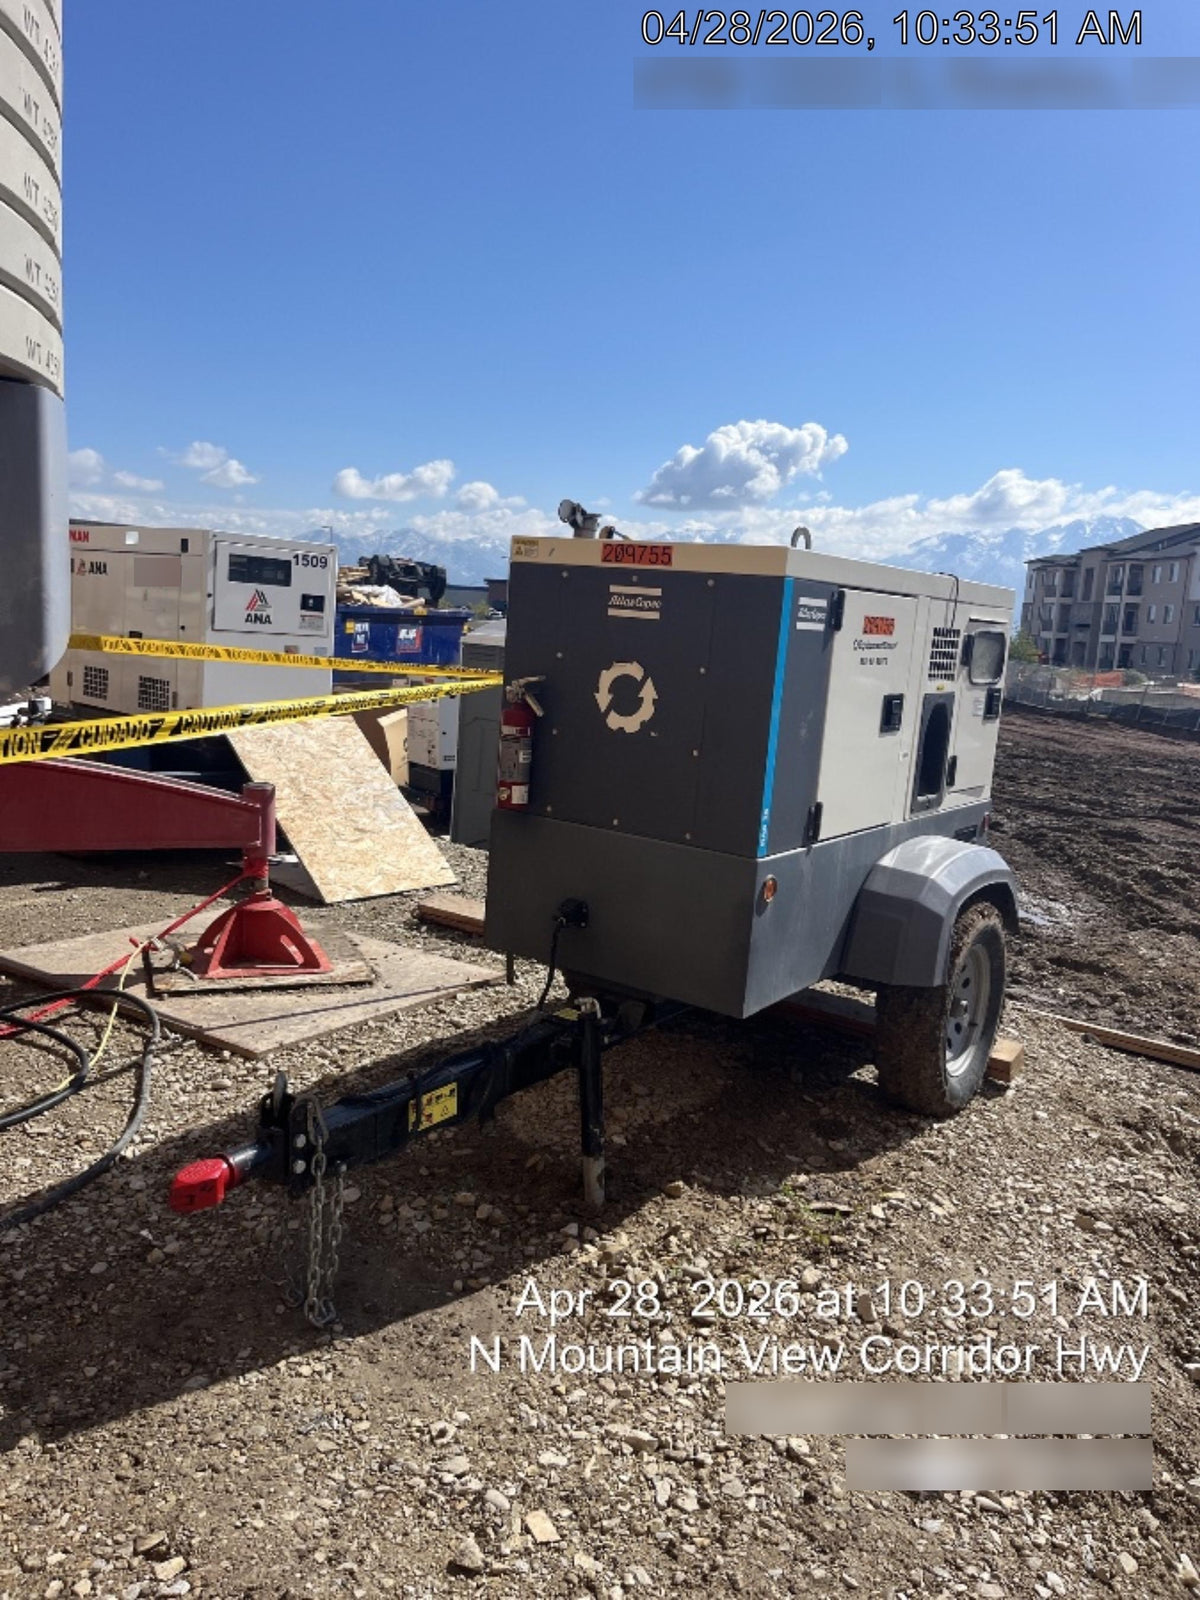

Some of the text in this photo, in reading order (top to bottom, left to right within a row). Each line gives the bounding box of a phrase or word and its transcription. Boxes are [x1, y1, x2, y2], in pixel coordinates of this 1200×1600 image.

[25, 335, 42, 366] WT
[292, 553, 328, 569] 1509
[602, 543, 673, 566] 209755
[88, 561, 108, 575] ANA
[245, 612, 272, 625] ANA
